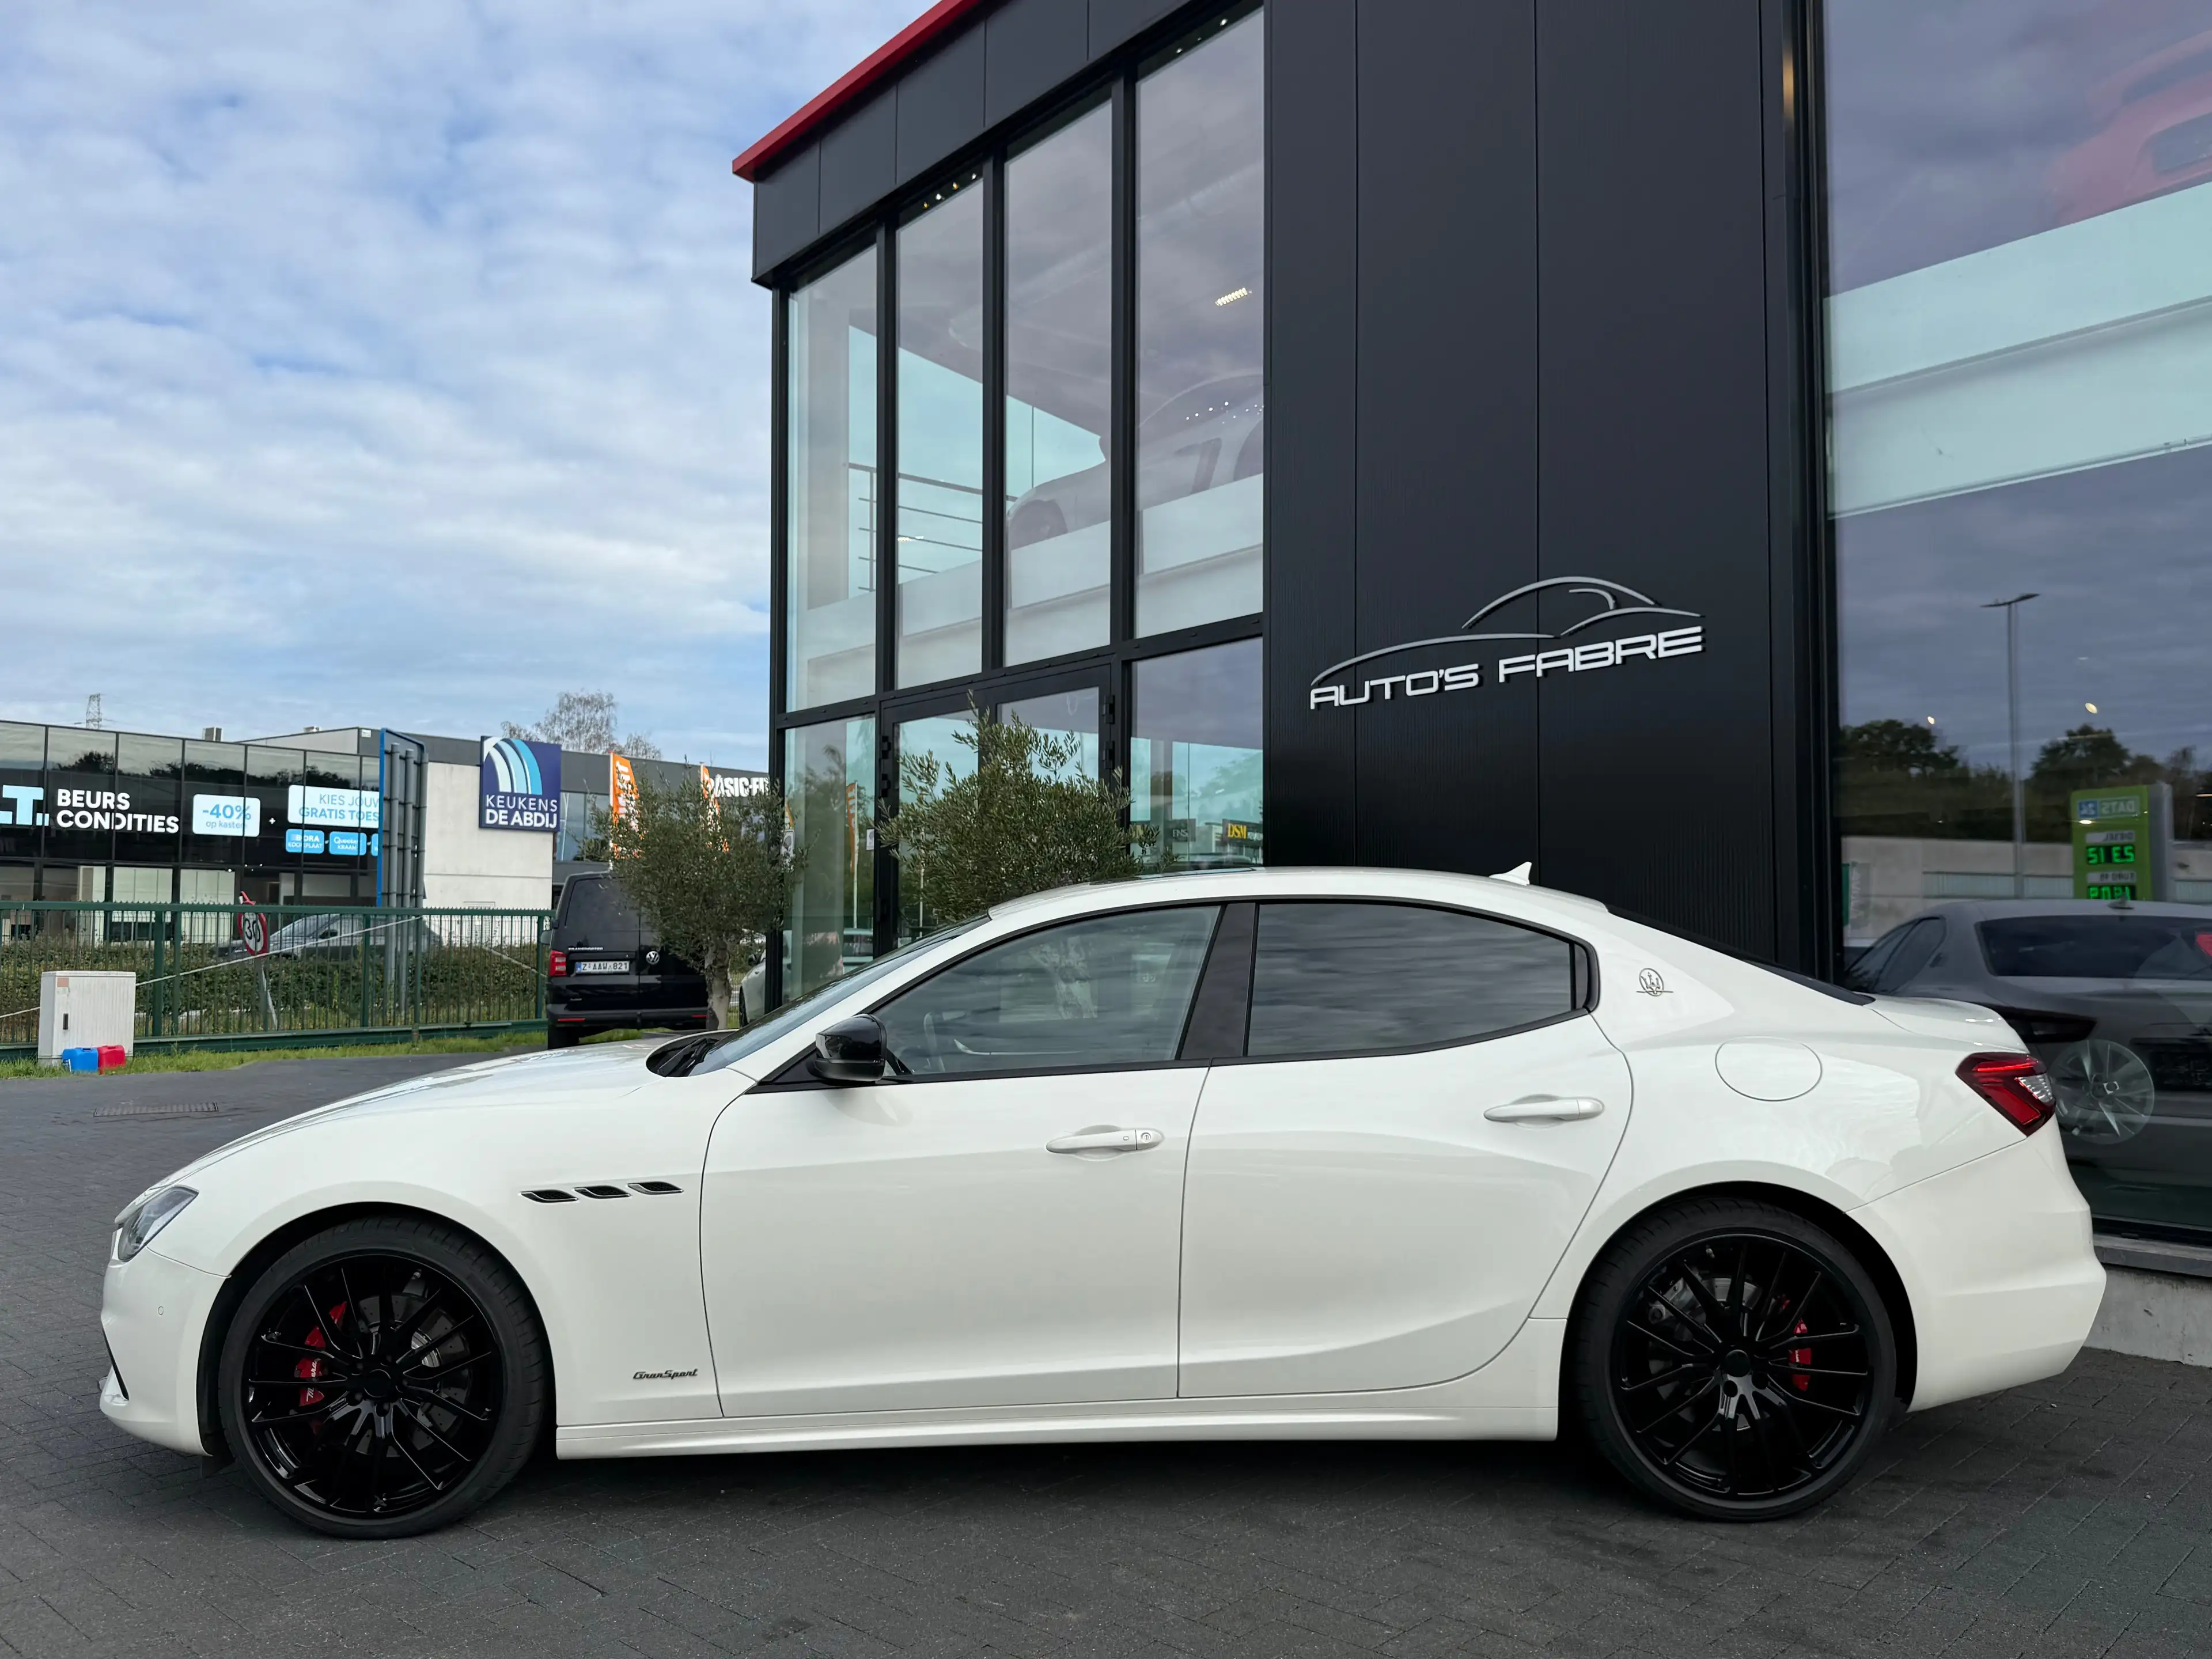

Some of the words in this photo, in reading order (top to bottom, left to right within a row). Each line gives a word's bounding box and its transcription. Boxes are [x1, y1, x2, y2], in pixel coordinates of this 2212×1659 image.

[1310, 664, 1479, 710] AUTO'S
[1499, 626, 1703, 683] FABRE
[57, 789, 130, 810] BEURS
[319, 793, 345, 805] KIES
[486, 794, 558, 812] KEUKENS
[202, 804, 252, 820] -40%
[298, 806, 346, 819] GRATIS
[486, 808, 508, 825] DE
[510, 810, 557, 829] ABDIJ
[56, 809, 180, 834] CONDITIES
[206, 821, 217, 829] op
